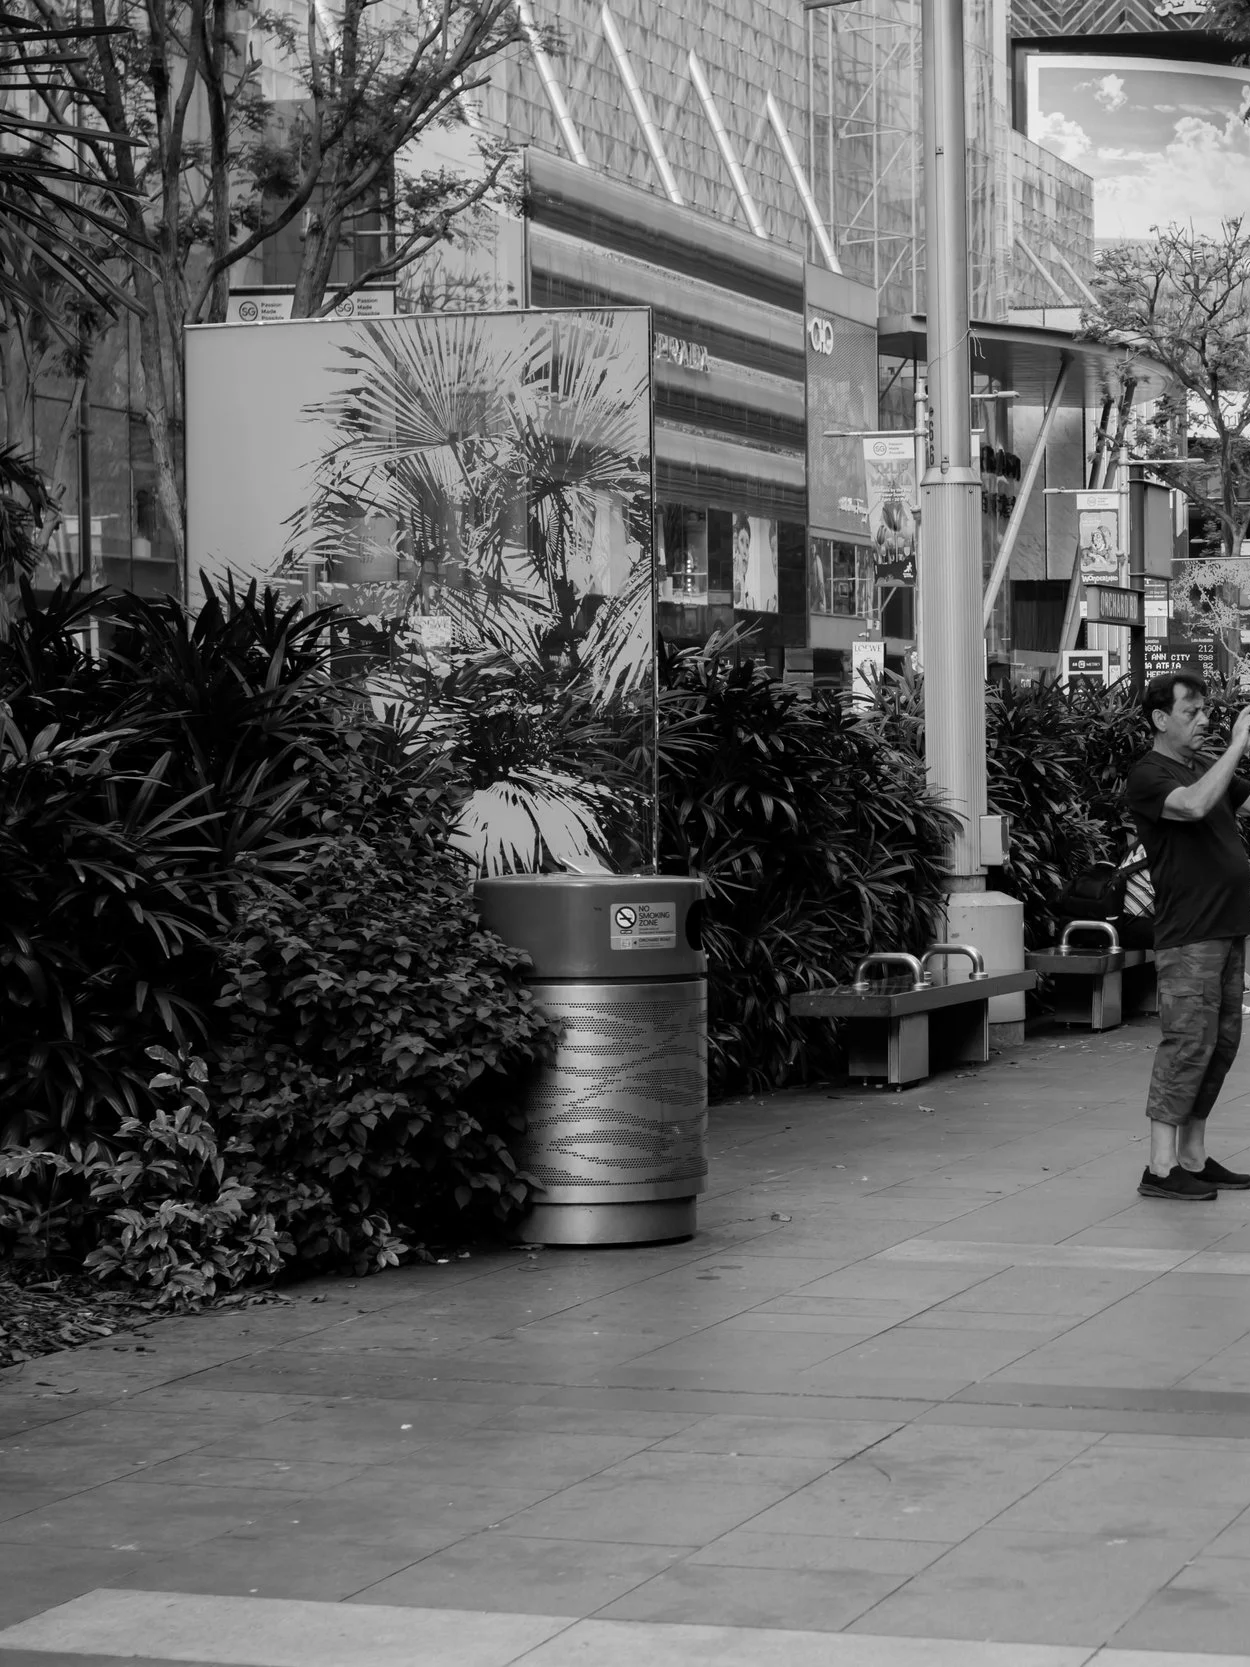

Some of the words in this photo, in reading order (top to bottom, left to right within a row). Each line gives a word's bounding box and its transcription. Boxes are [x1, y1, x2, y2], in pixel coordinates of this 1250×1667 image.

[240, 307, 256, 317] SG
[336, 301, 352, 313] SG
[1100, 591, 1129, 618] ORCHARD
[1129, 595, 1138, 620] RD
[1198, 644, 1214, 653] 212
[1151, 653, 1167, 661] ANN
